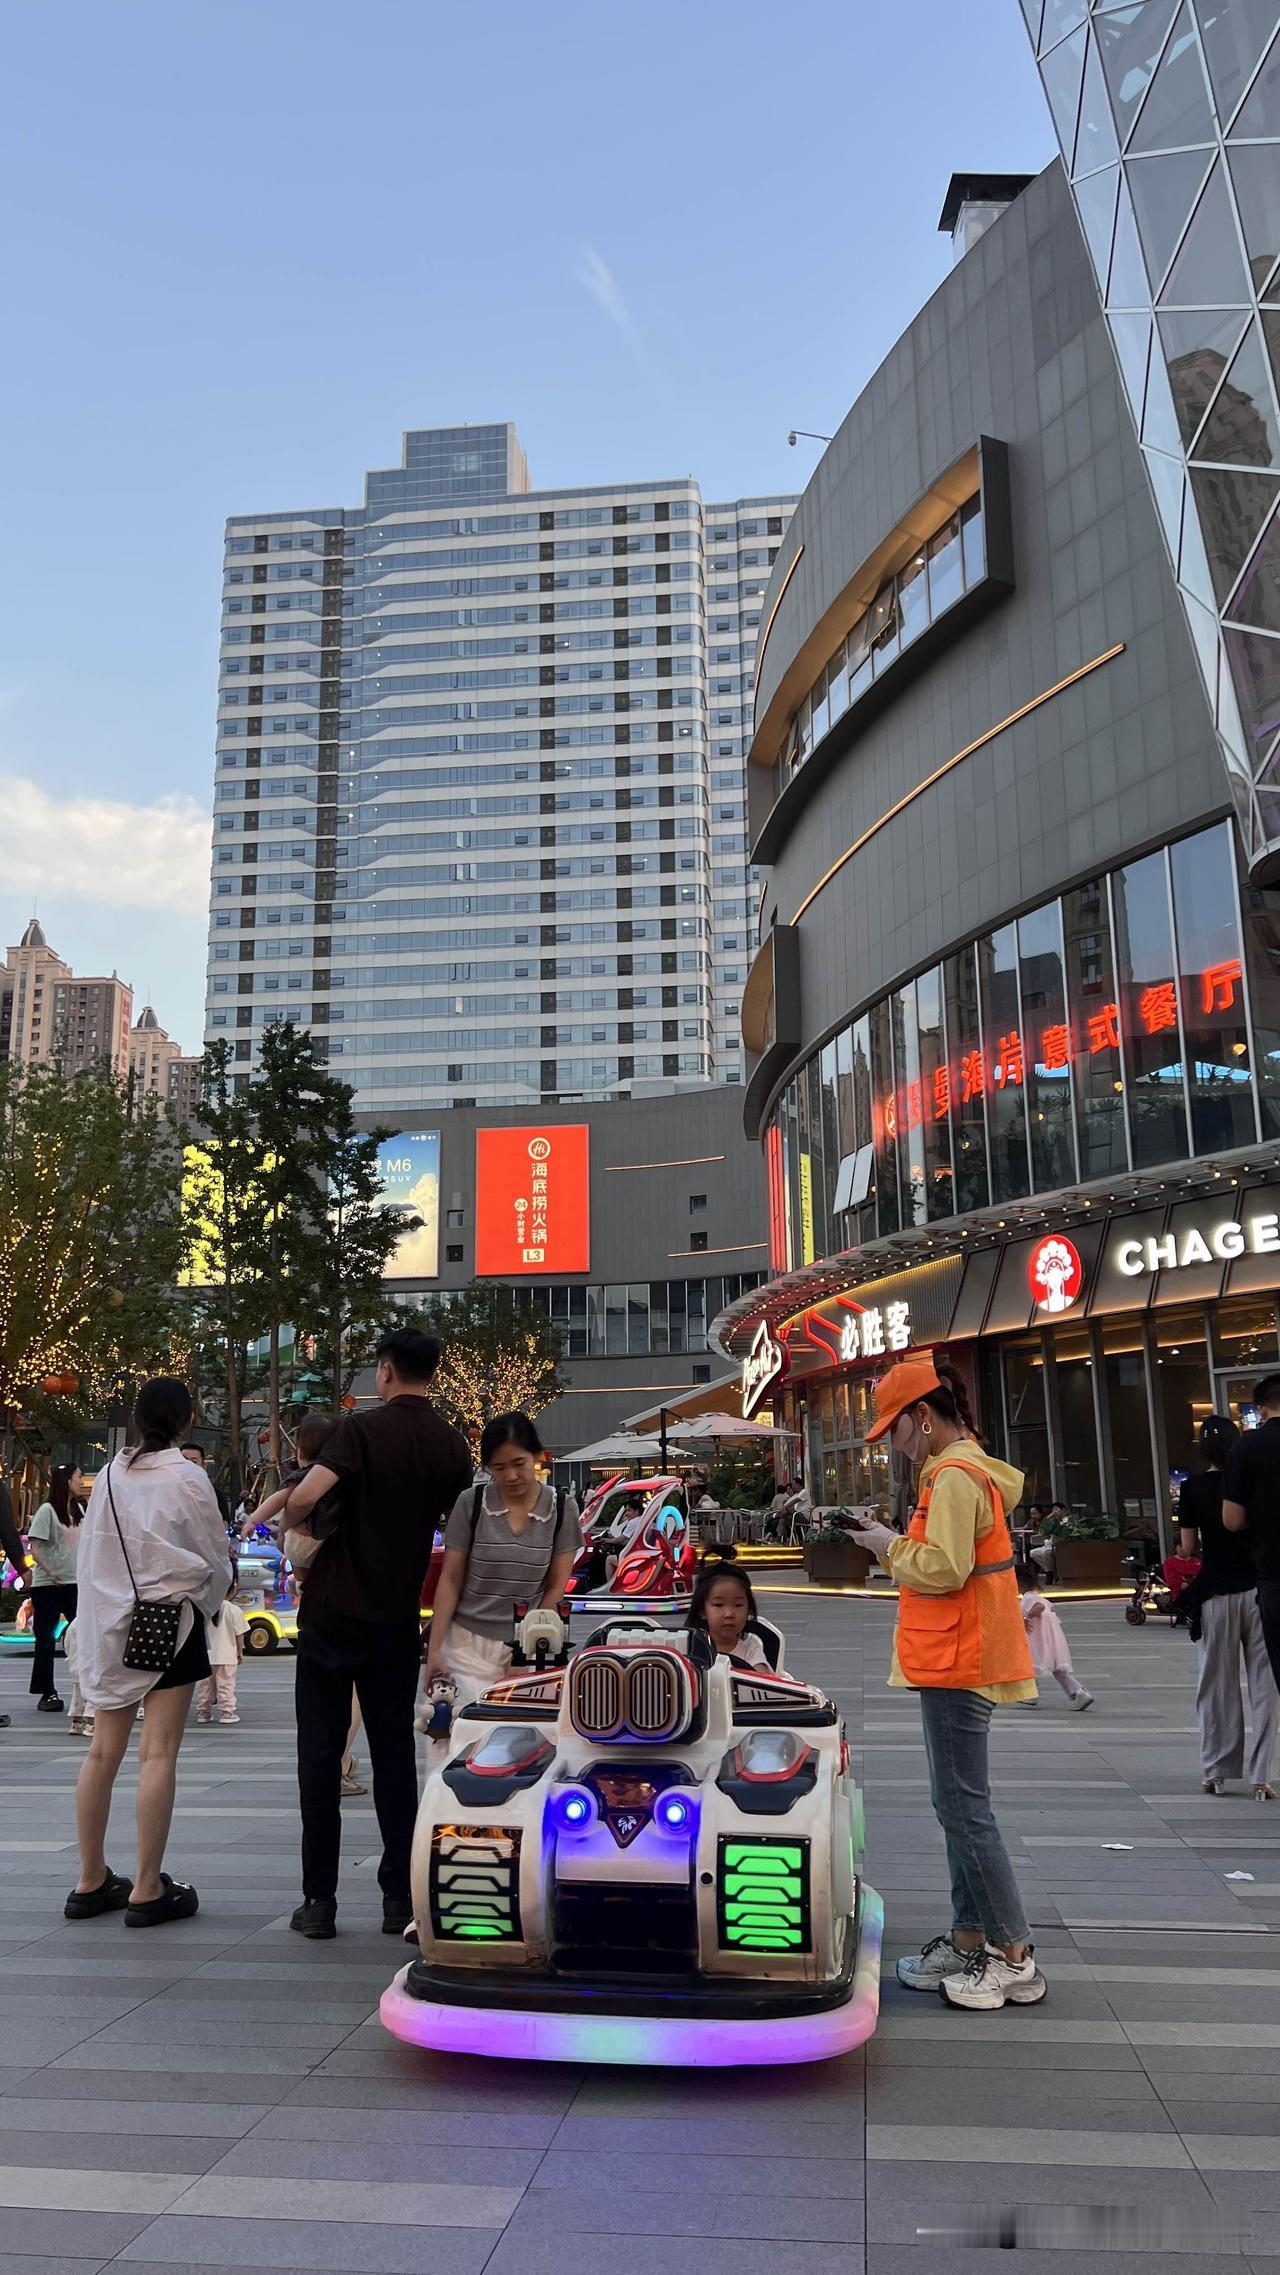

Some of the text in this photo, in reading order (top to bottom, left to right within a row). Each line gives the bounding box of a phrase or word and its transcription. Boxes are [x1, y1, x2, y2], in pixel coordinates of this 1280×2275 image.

[386, 1158, 412, 1173] M6
[531, 1162, 548, 1244] 海底捞火锅
[525, 1249, 542, 1262] L3
[1117, 1213, 1280, 1276] CHAGE
[841, 1301, 911, 1360] 必胜客
